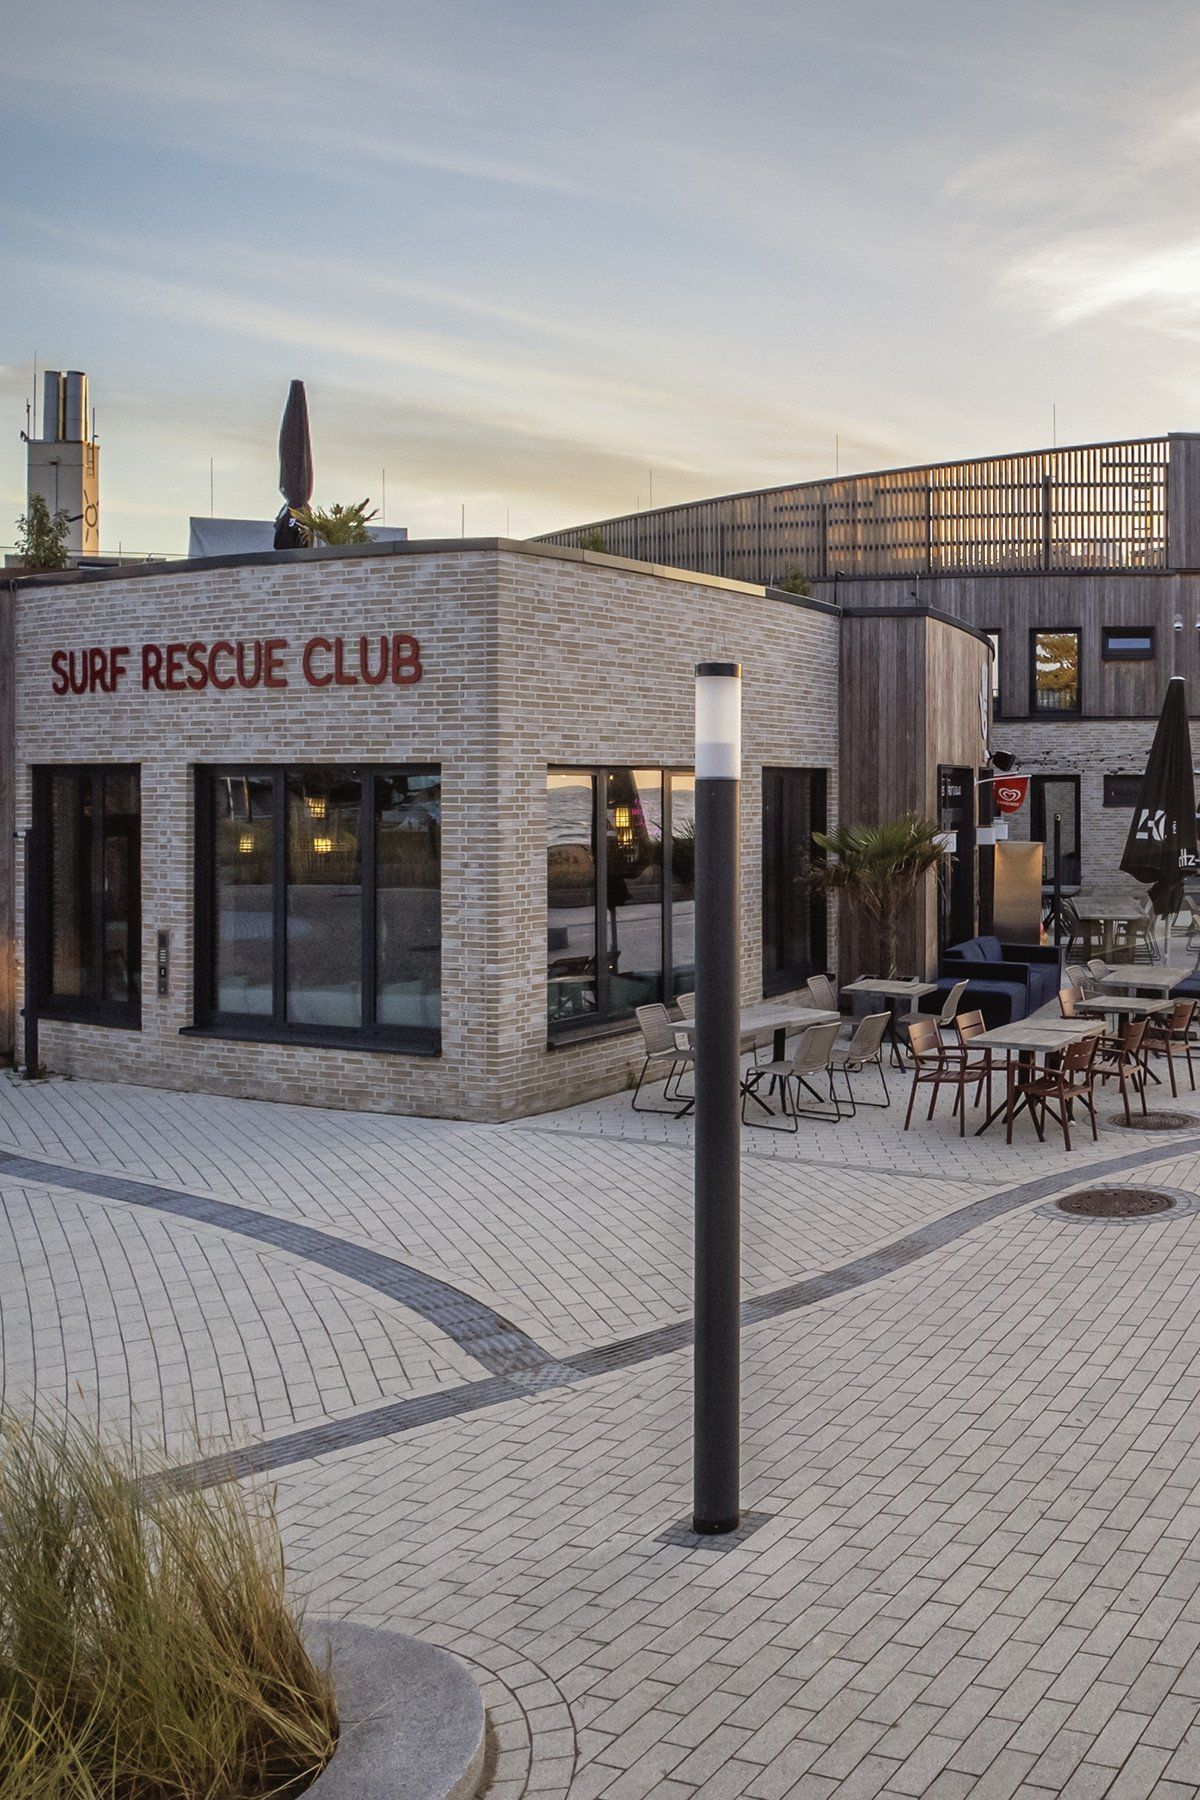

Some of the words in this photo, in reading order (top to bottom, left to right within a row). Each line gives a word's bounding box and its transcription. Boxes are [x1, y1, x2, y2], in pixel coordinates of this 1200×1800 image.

[52, 646, 129, 695] SURF
[142, 638, 289, 691] RESCUE
[302, 634, 423, 687] CLUB
